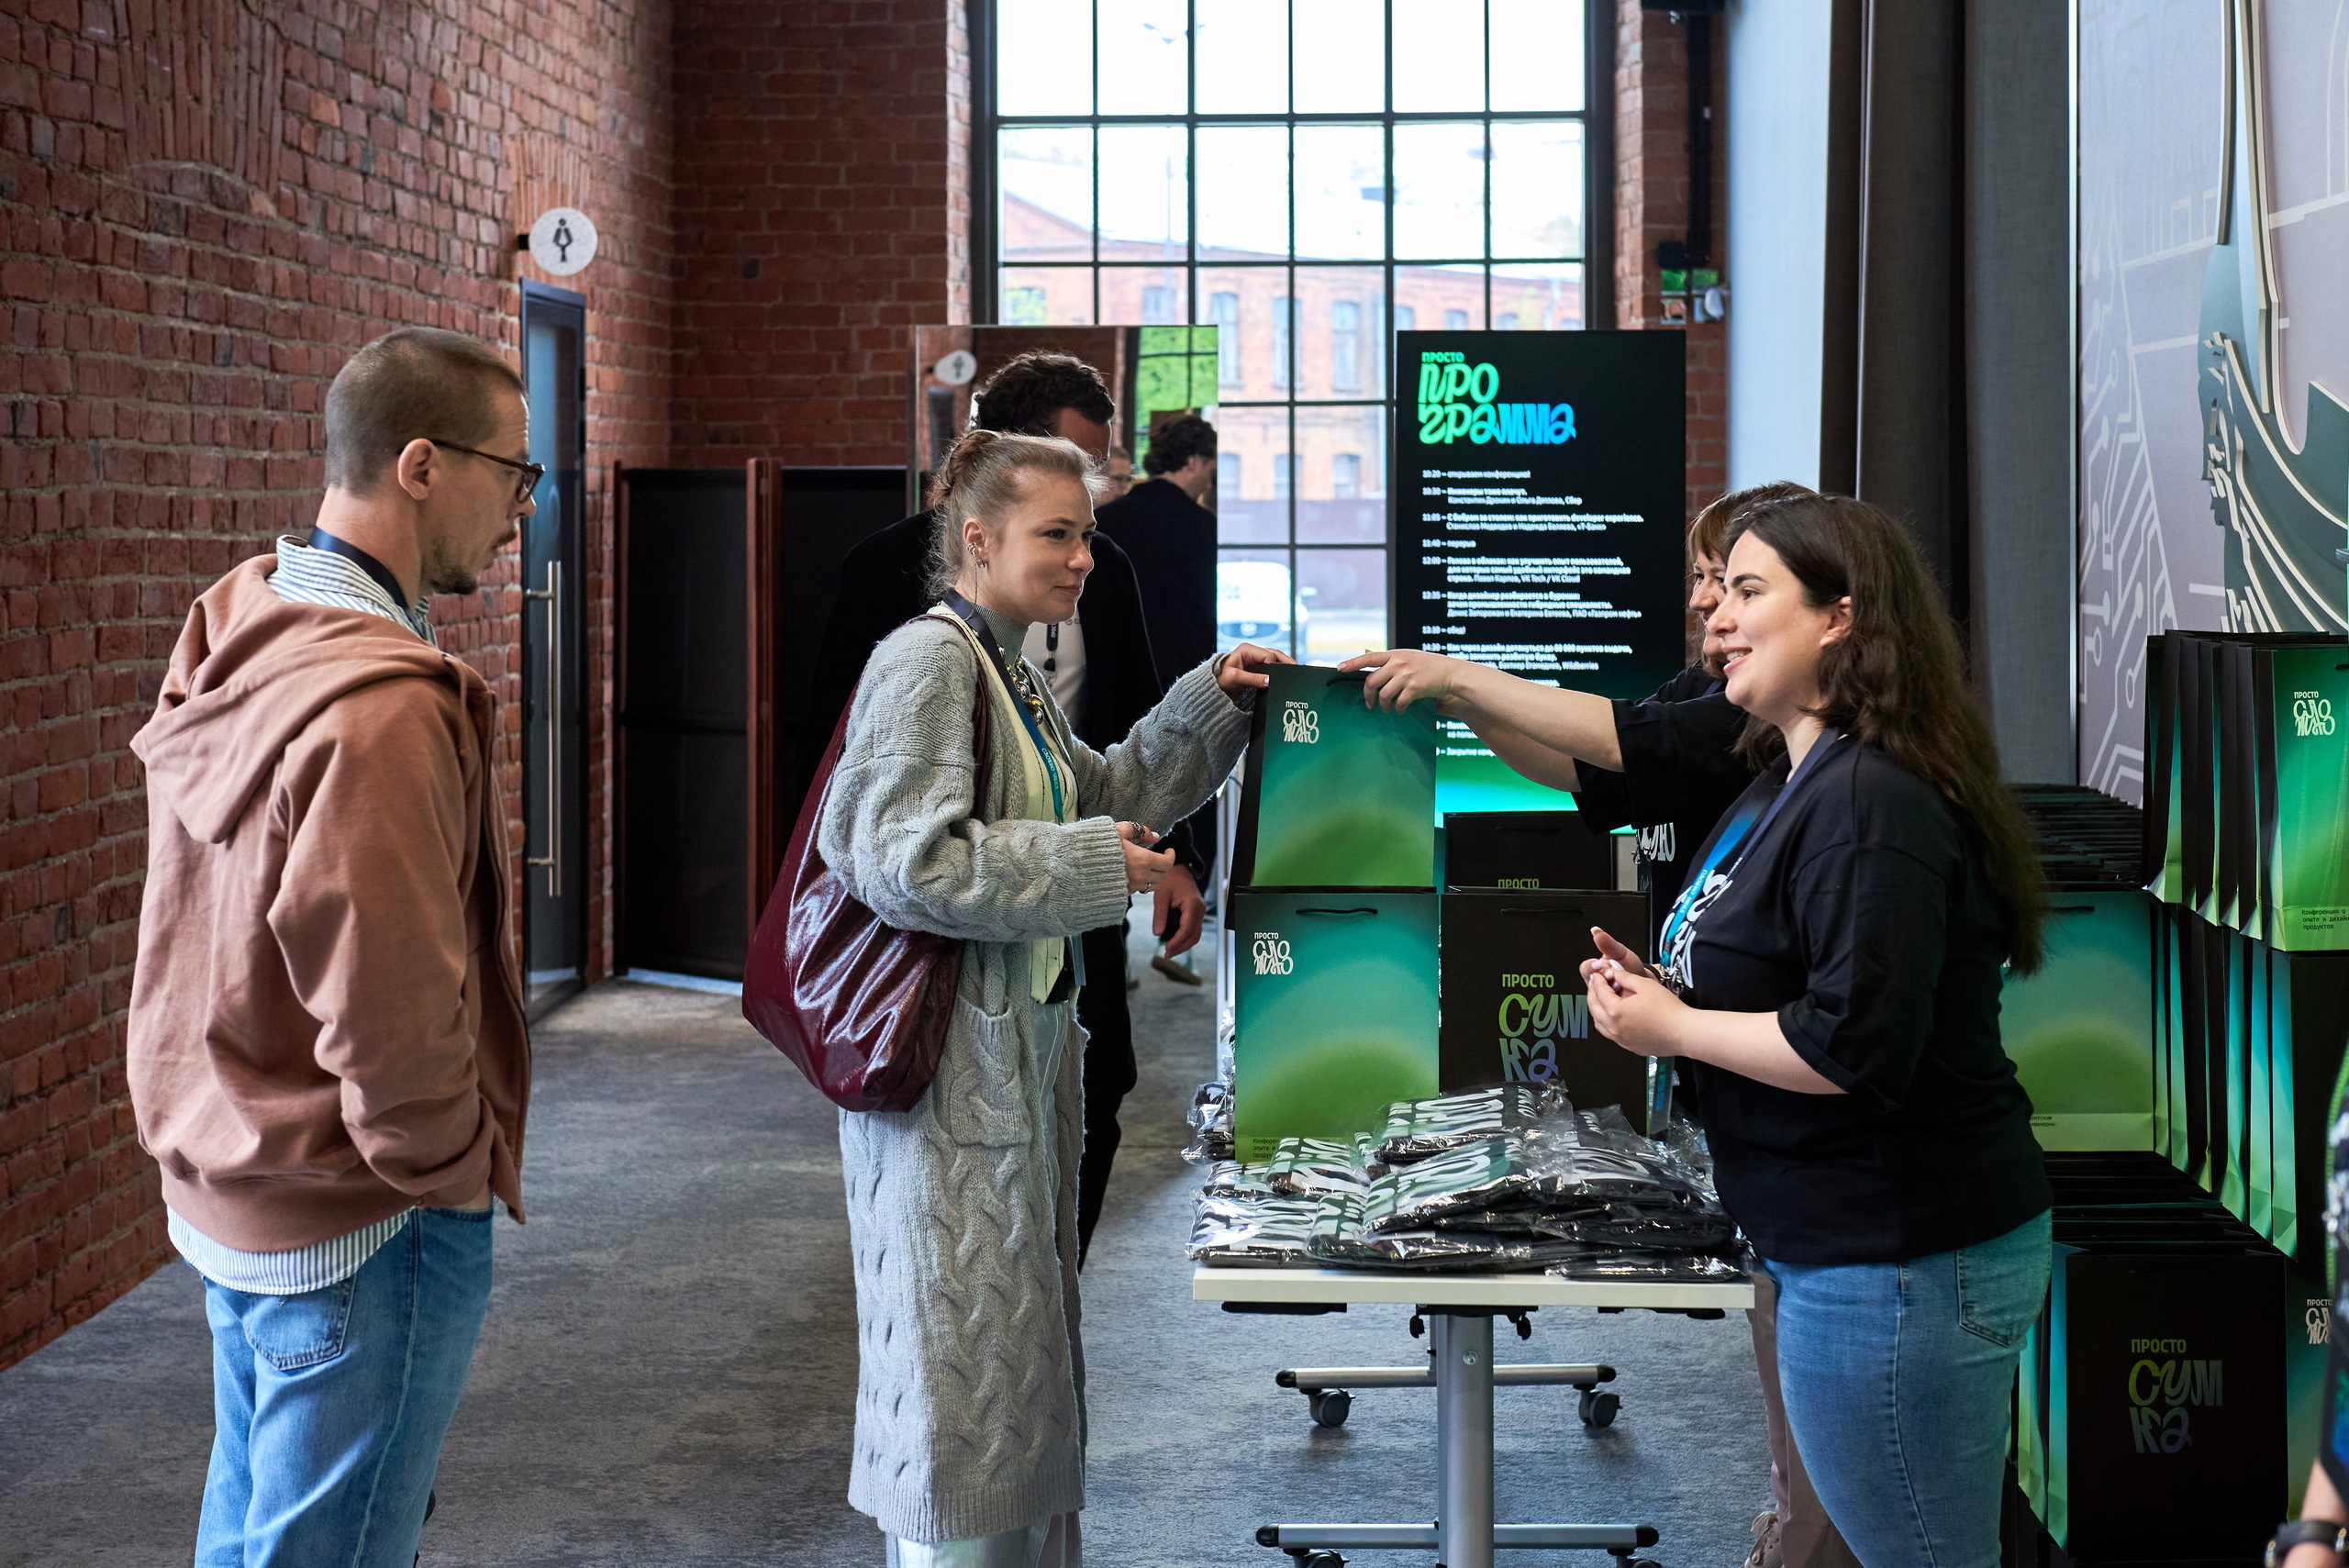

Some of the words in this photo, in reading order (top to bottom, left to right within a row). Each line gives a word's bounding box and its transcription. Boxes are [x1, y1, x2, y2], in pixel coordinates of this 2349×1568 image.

[1421, 351, 1464, 363] ПРОСТО
[2294, 691, 2320, 699] ПРОСТО
[1285, 700, 1309, 710] ПРОСТО
[1497, 878, 1540, 889] ПРОСТО
[1253, 931, 1279, 940] ПРОСТО
[1501, 973, 1554, 988] ПРОСТО
[2132, 1339, 2187, 1353] ПРОСТО
